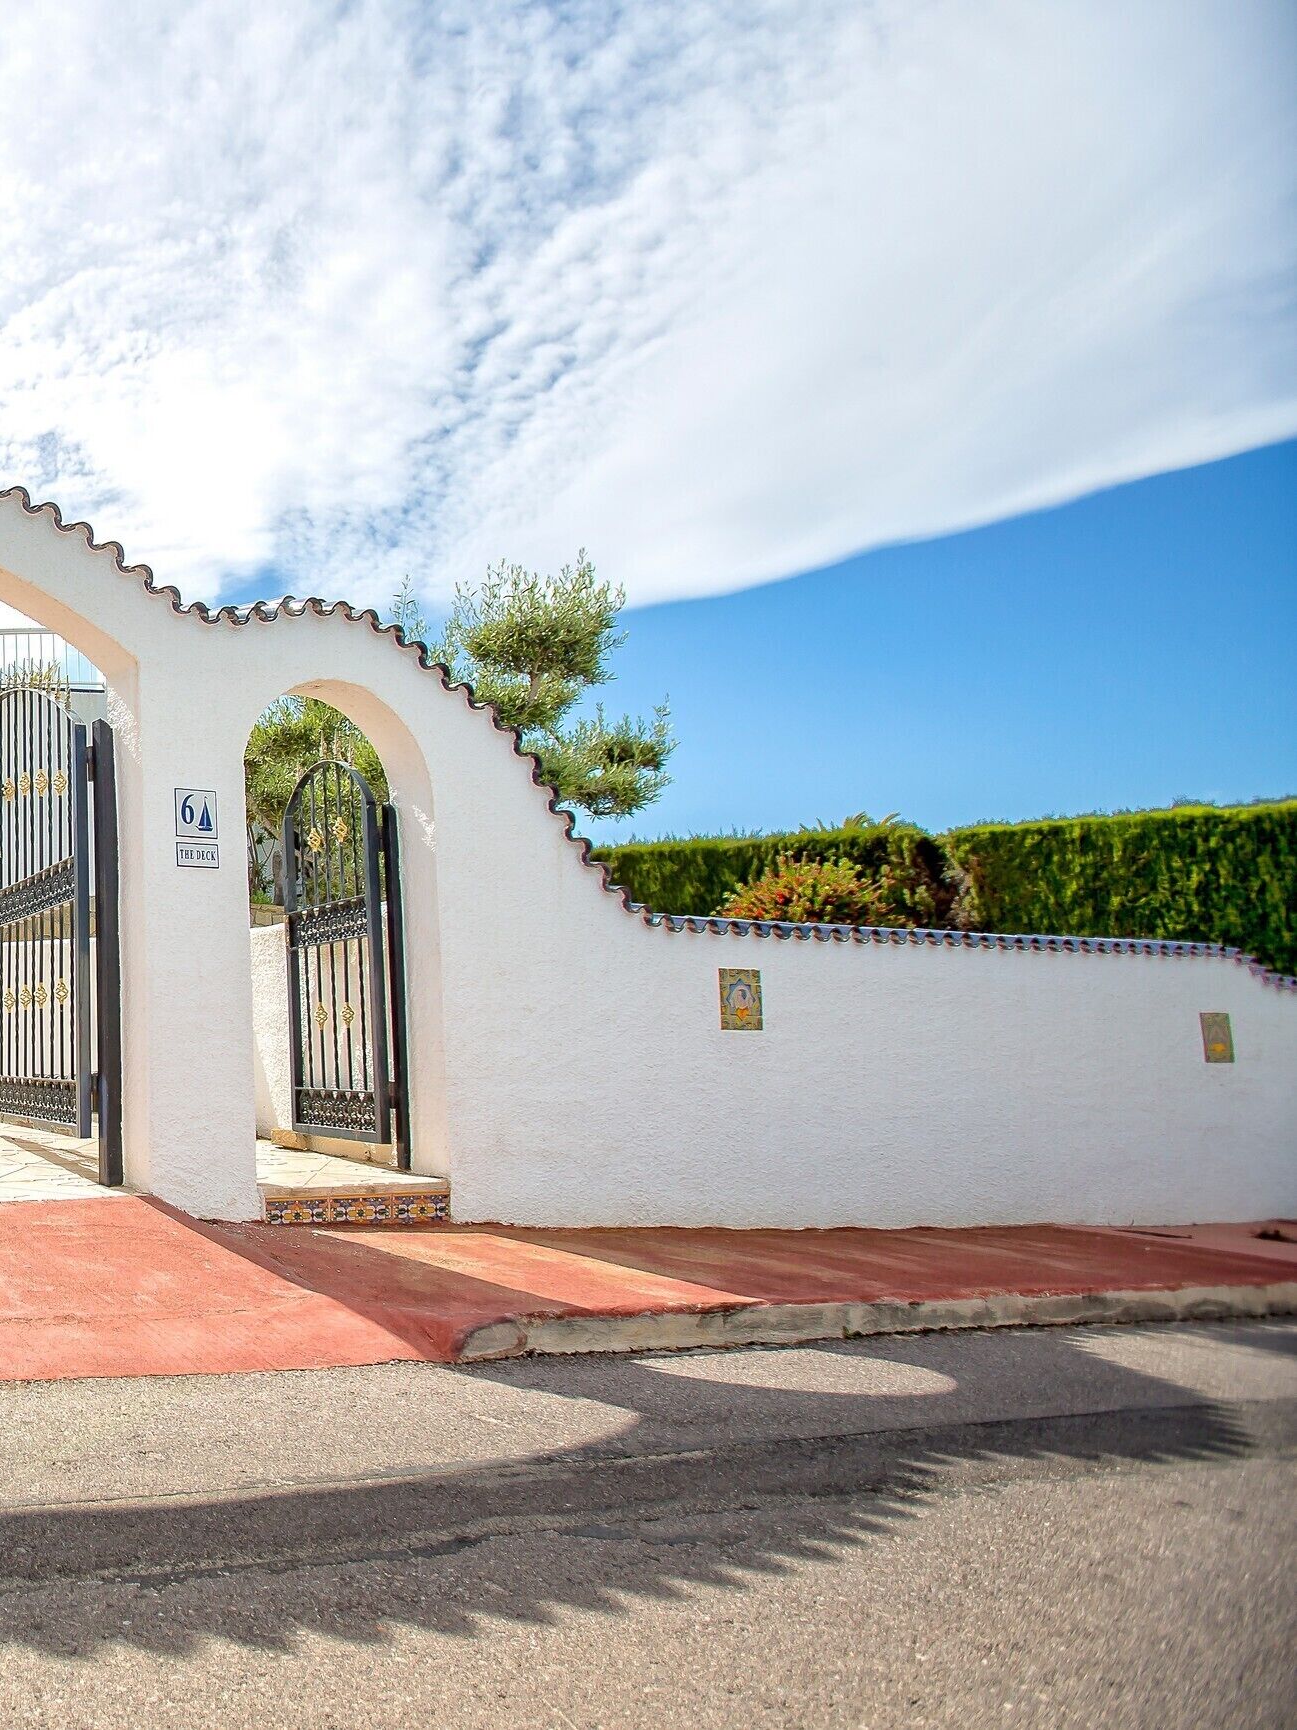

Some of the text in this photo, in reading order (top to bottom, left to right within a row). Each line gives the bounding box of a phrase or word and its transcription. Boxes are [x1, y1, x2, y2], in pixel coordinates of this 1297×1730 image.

[181, 794, 195, 825] 6
[180, 849, 216, 861] THE DECK
